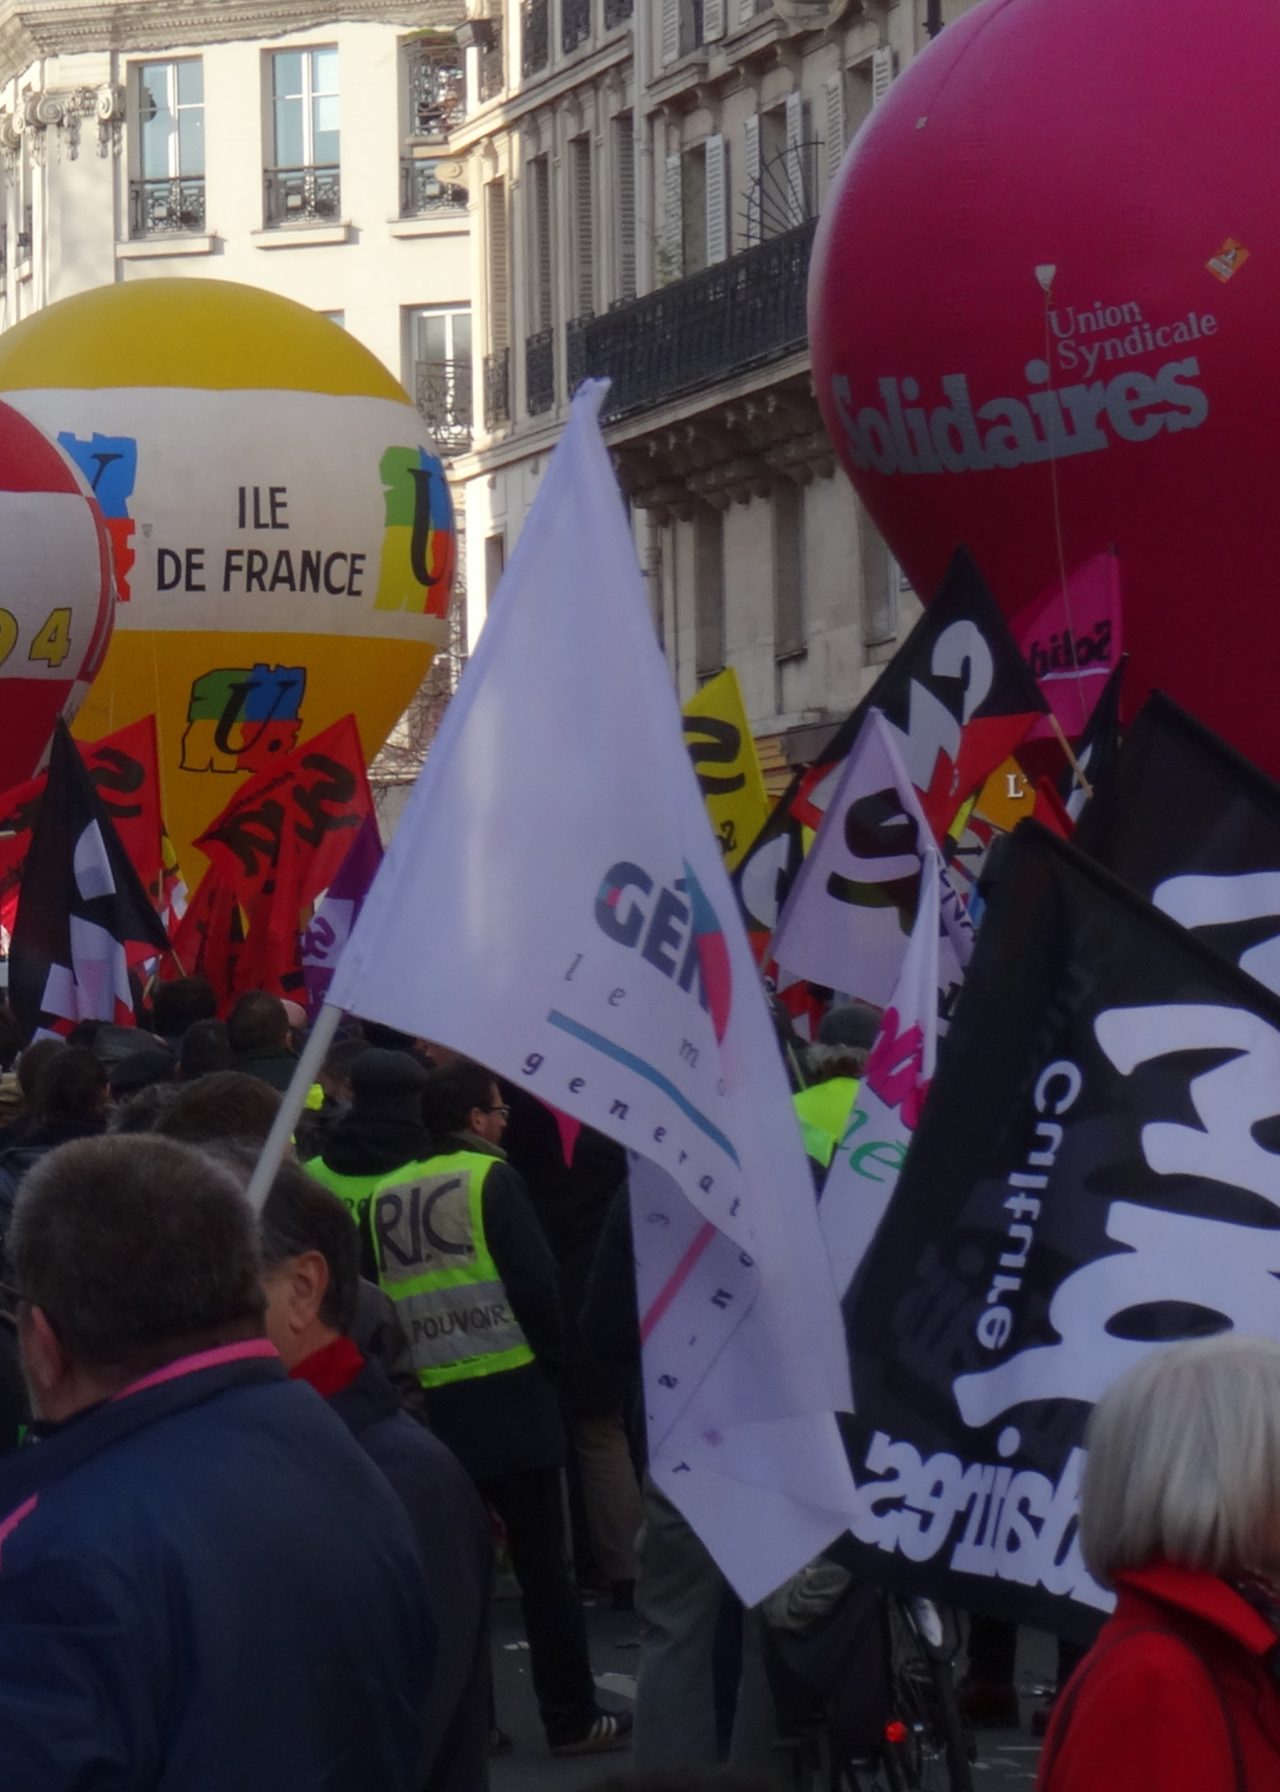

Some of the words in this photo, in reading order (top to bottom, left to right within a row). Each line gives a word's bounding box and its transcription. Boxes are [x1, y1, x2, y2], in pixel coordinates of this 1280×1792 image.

[1048, 300, 1143, 338] Union
[1056, 312, 1219, 379] Syndicale
[238, 485, 290, 530] ILE
[157, 548, 206, 592] DE
[222, 548, 367, 598] FRANCE
[411, 1303, 511, 1343] POUVOIR
